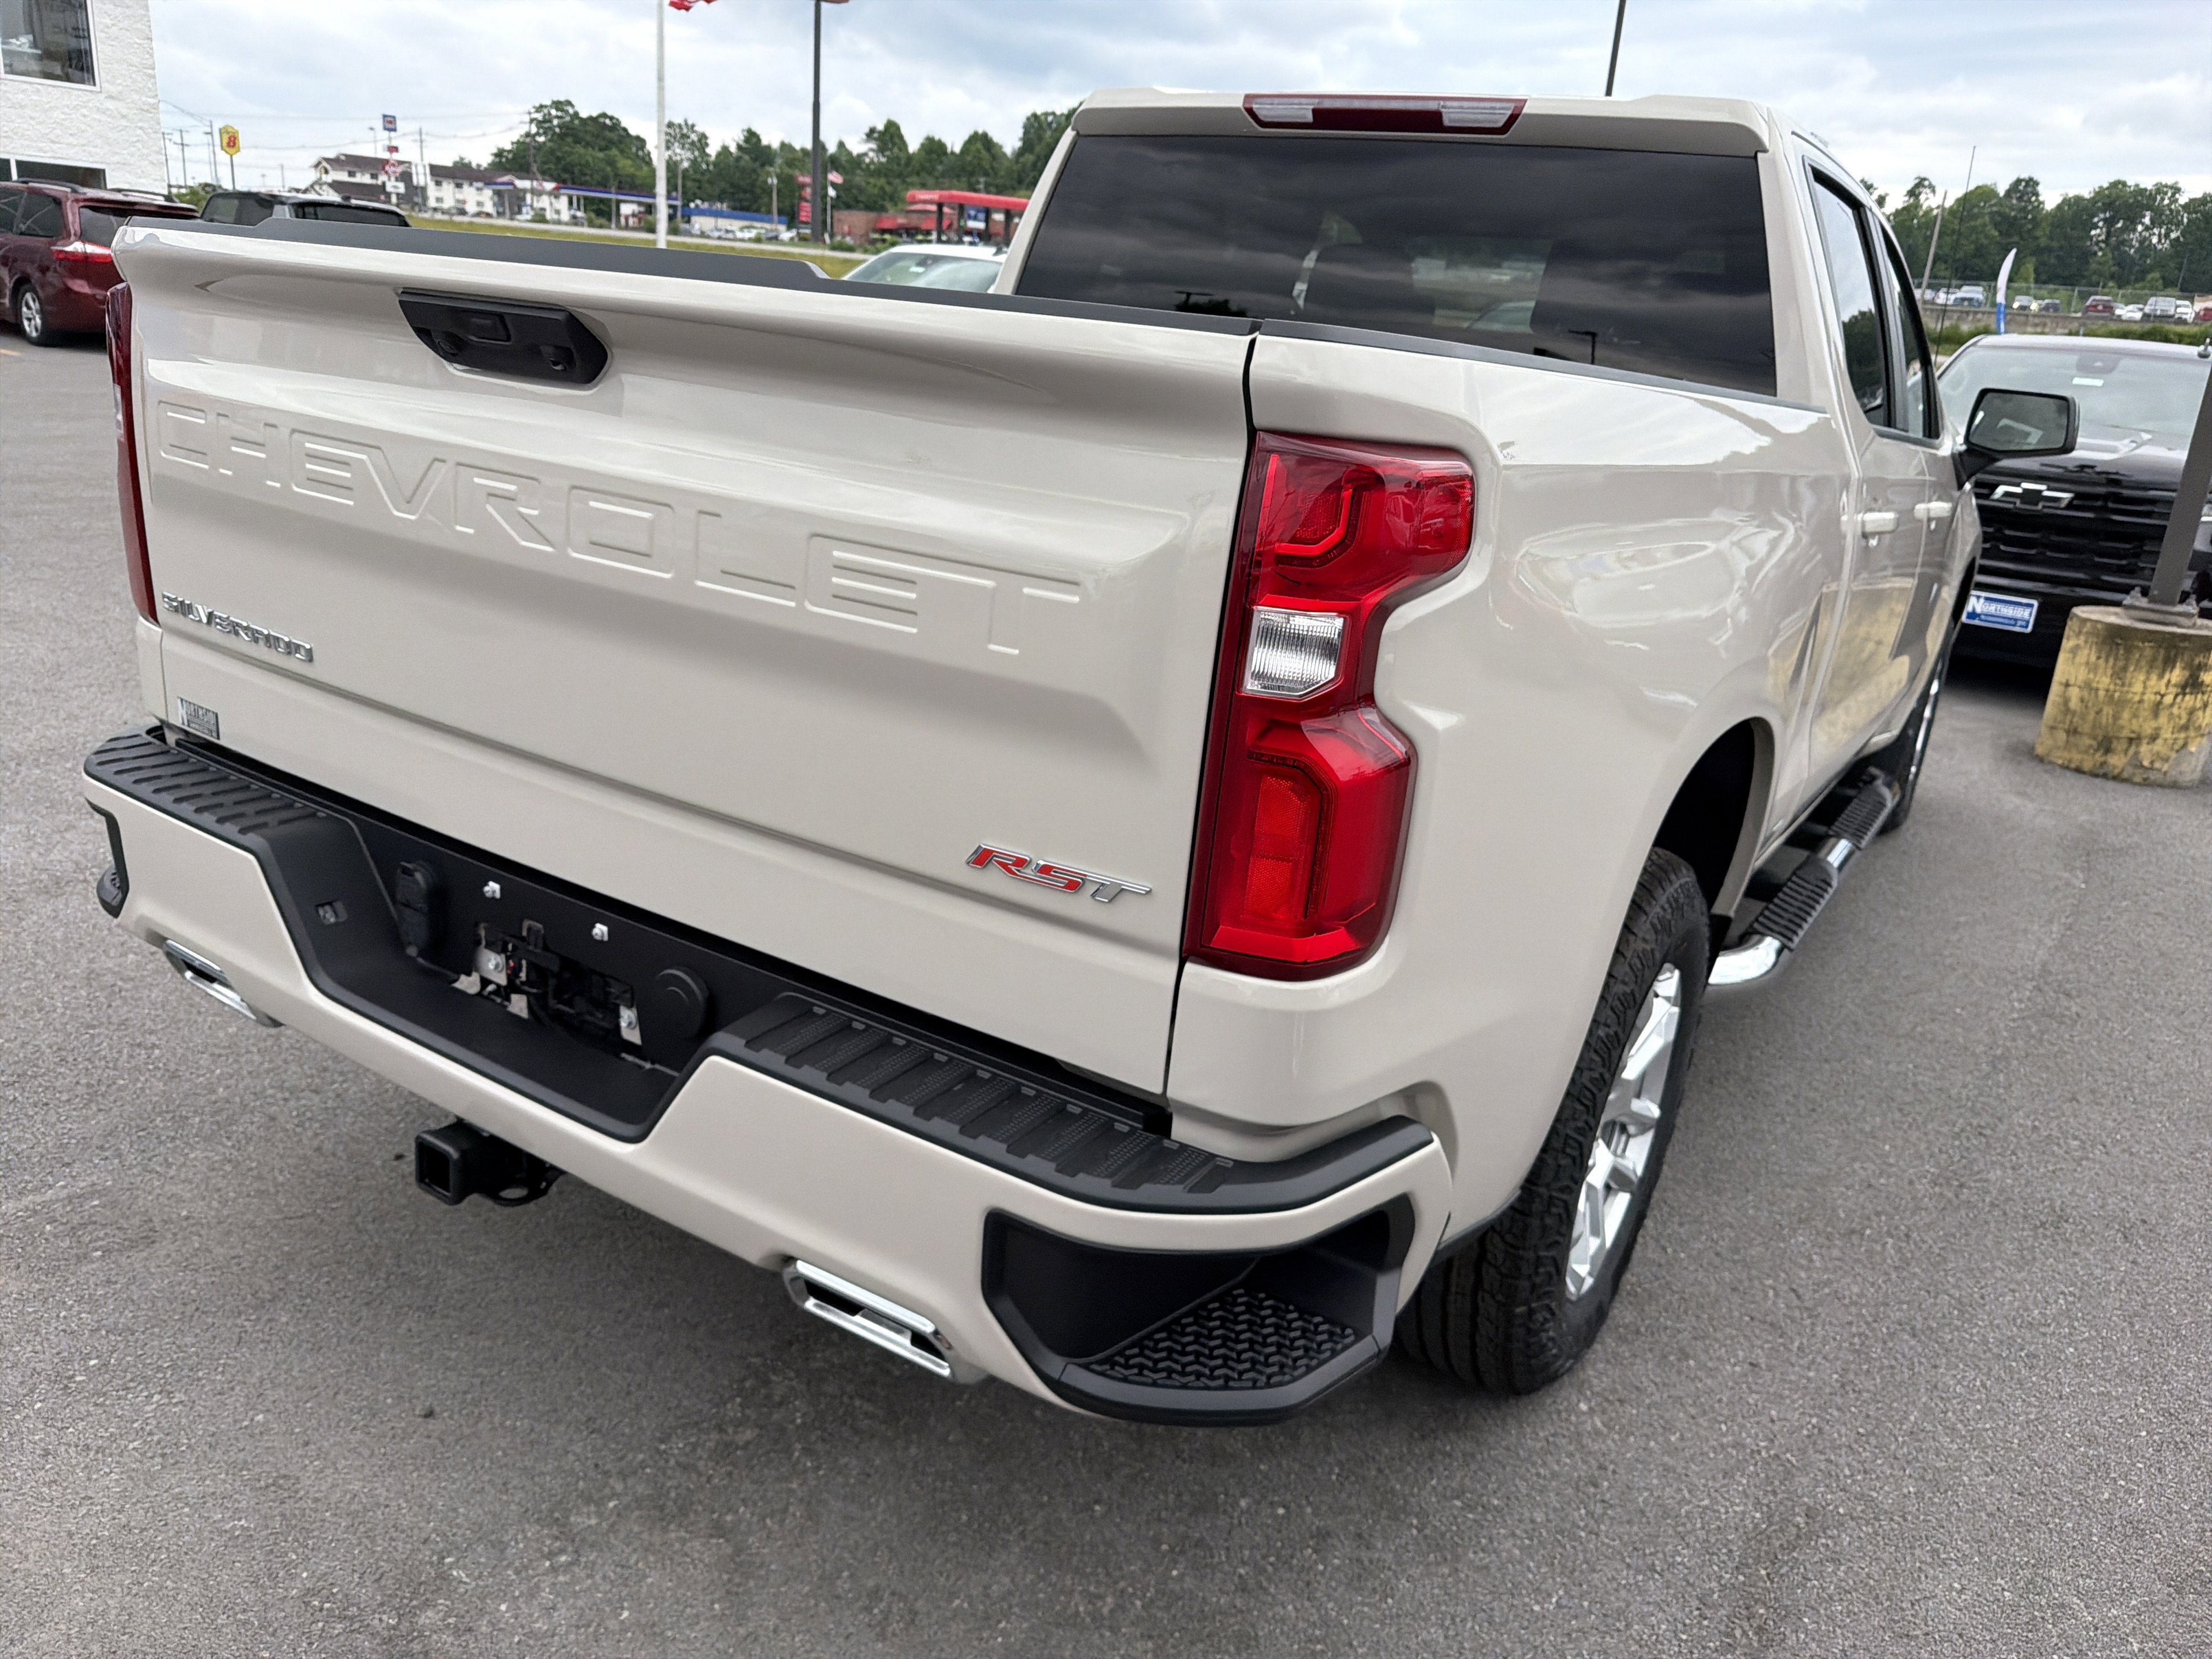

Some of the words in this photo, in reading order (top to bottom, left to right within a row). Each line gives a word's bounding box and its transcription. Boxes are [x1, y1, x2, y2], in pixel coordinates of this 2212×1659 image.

[227, 135, 237, 148] 8
[158, 400, 1081, 654] CHEVROLET
[162, 591, 313, 662] SILVERADO
[1967, 595, 2032, 618] NORTHSIDE
[965, 844, 1152, 902] RST
